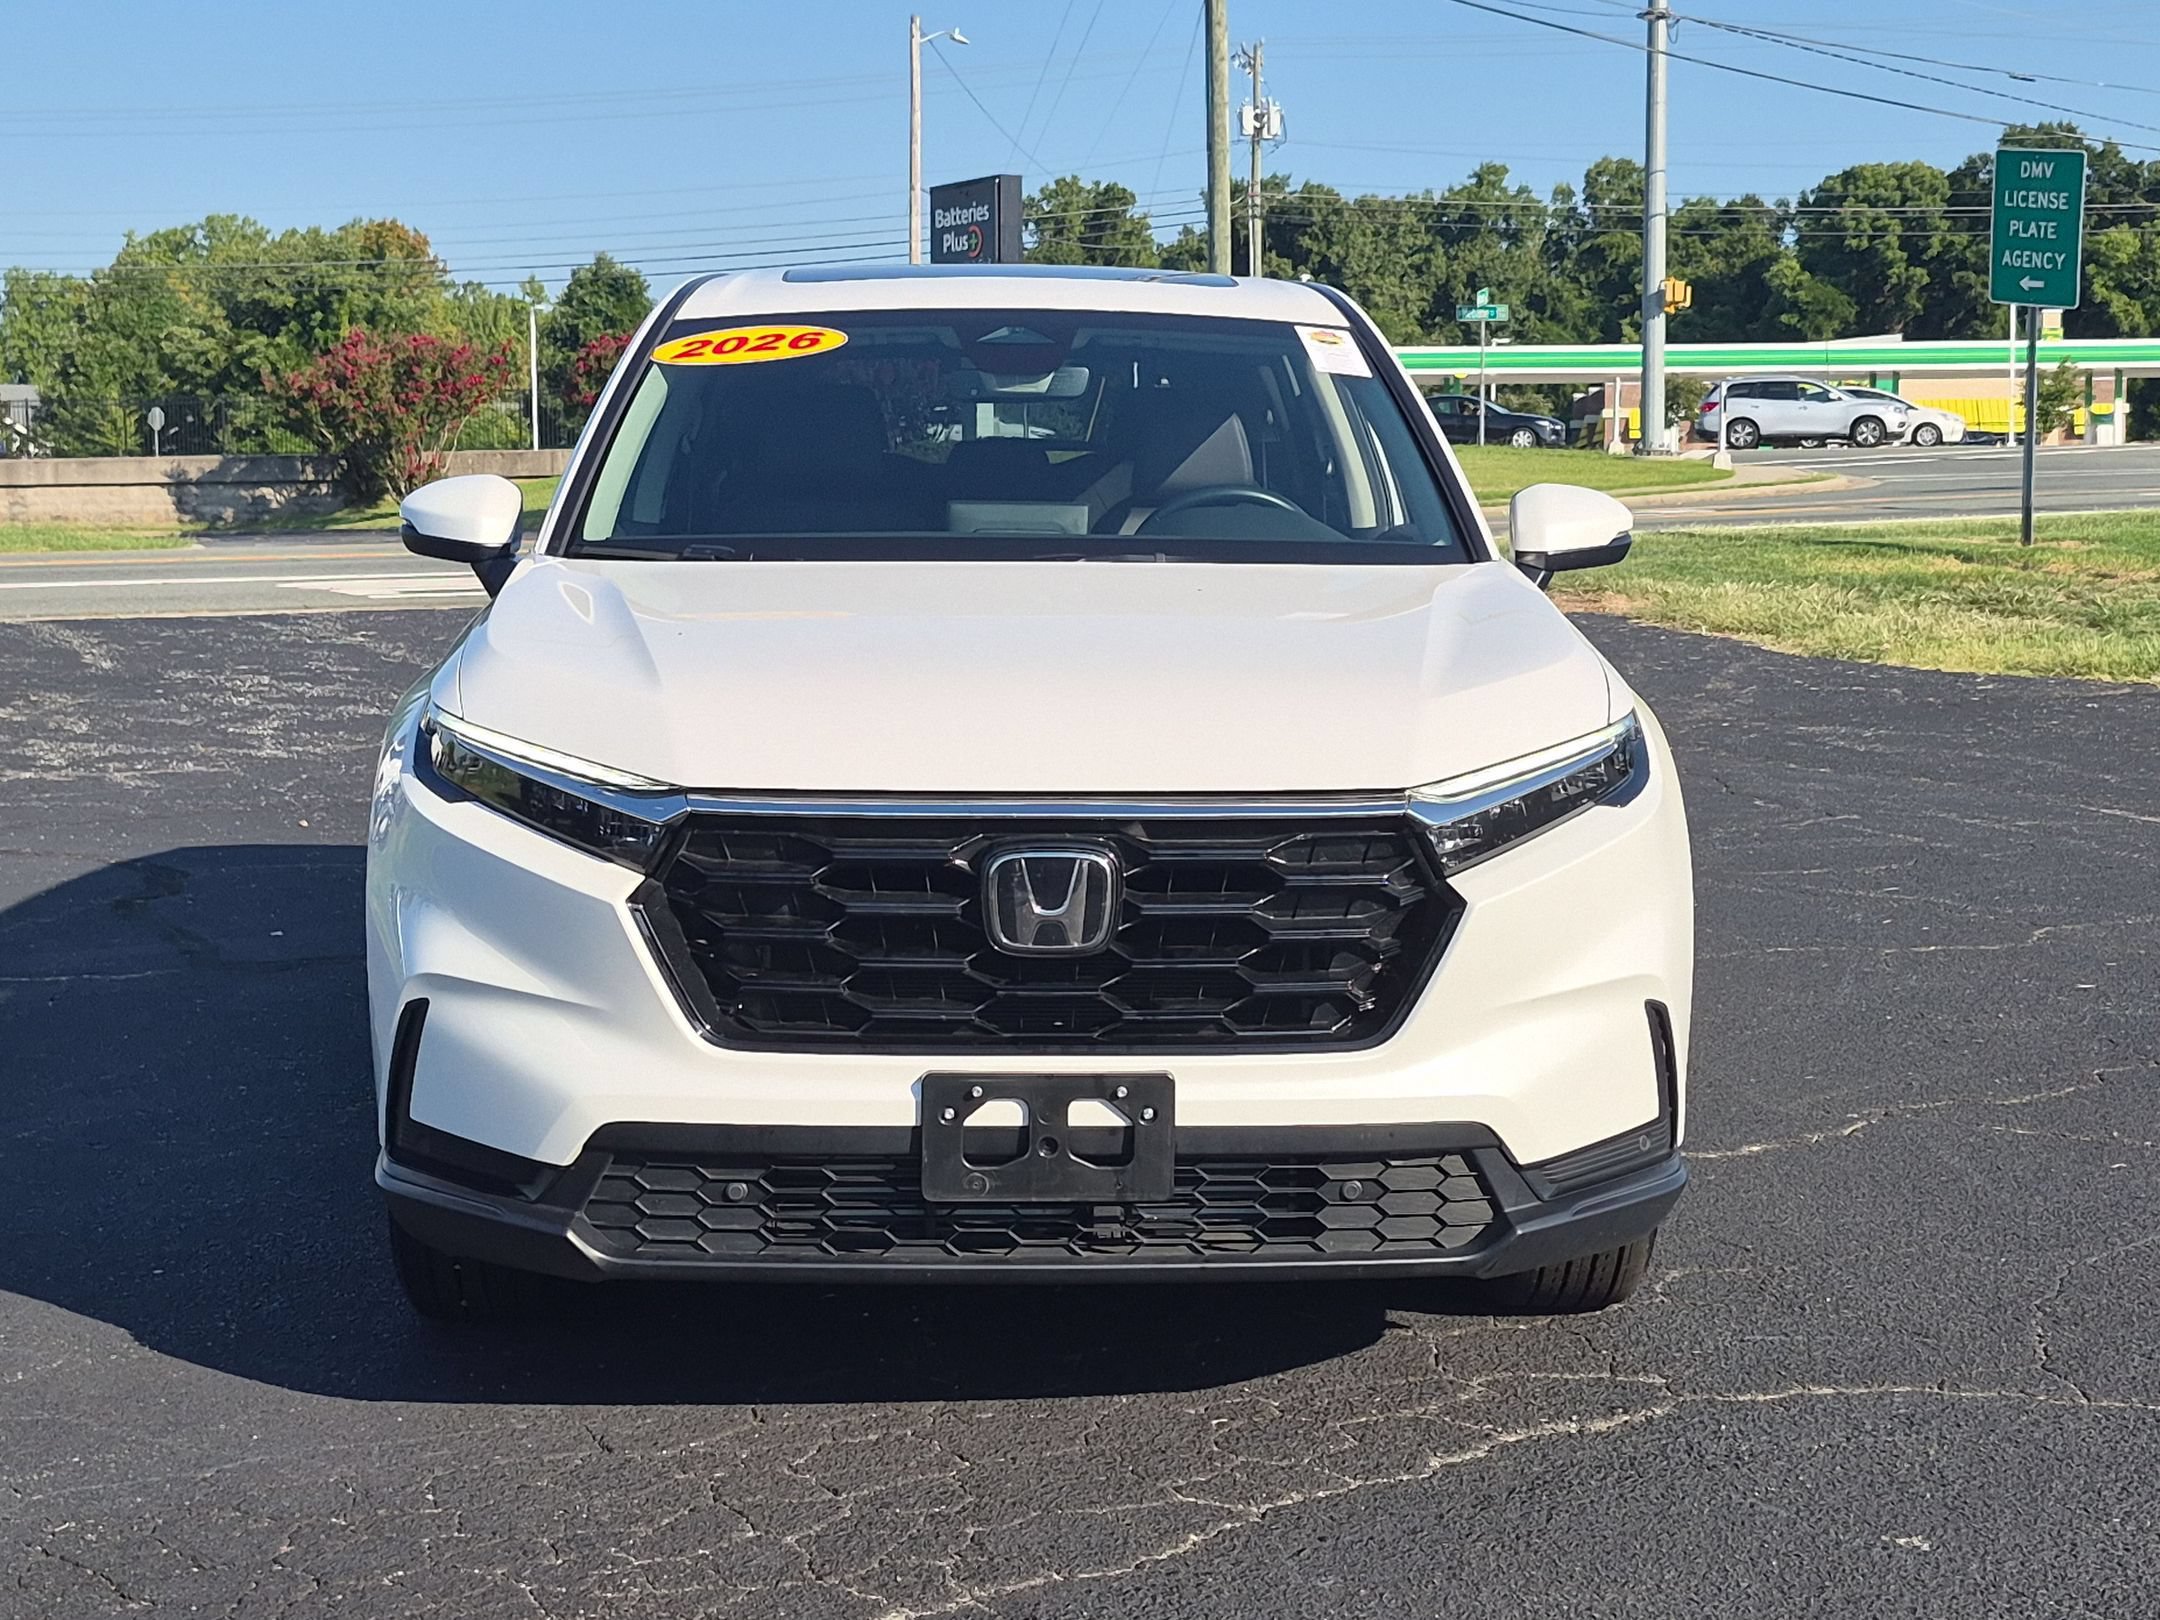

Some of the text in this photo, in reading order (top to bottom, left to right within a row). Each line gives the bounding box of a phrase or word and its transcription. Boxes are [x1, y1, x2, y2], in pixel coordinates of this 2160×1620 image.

[2020, 161, 2055, 178] DMV
[2004, 190, 2069, 209] LICENSE
[934, 201, 990, 229] Batteries
[2009, 220, 2058, 239] PLATE
[2001, 249, 2067, 270] AGENCY
[670, 332, 826, 360] 2026
